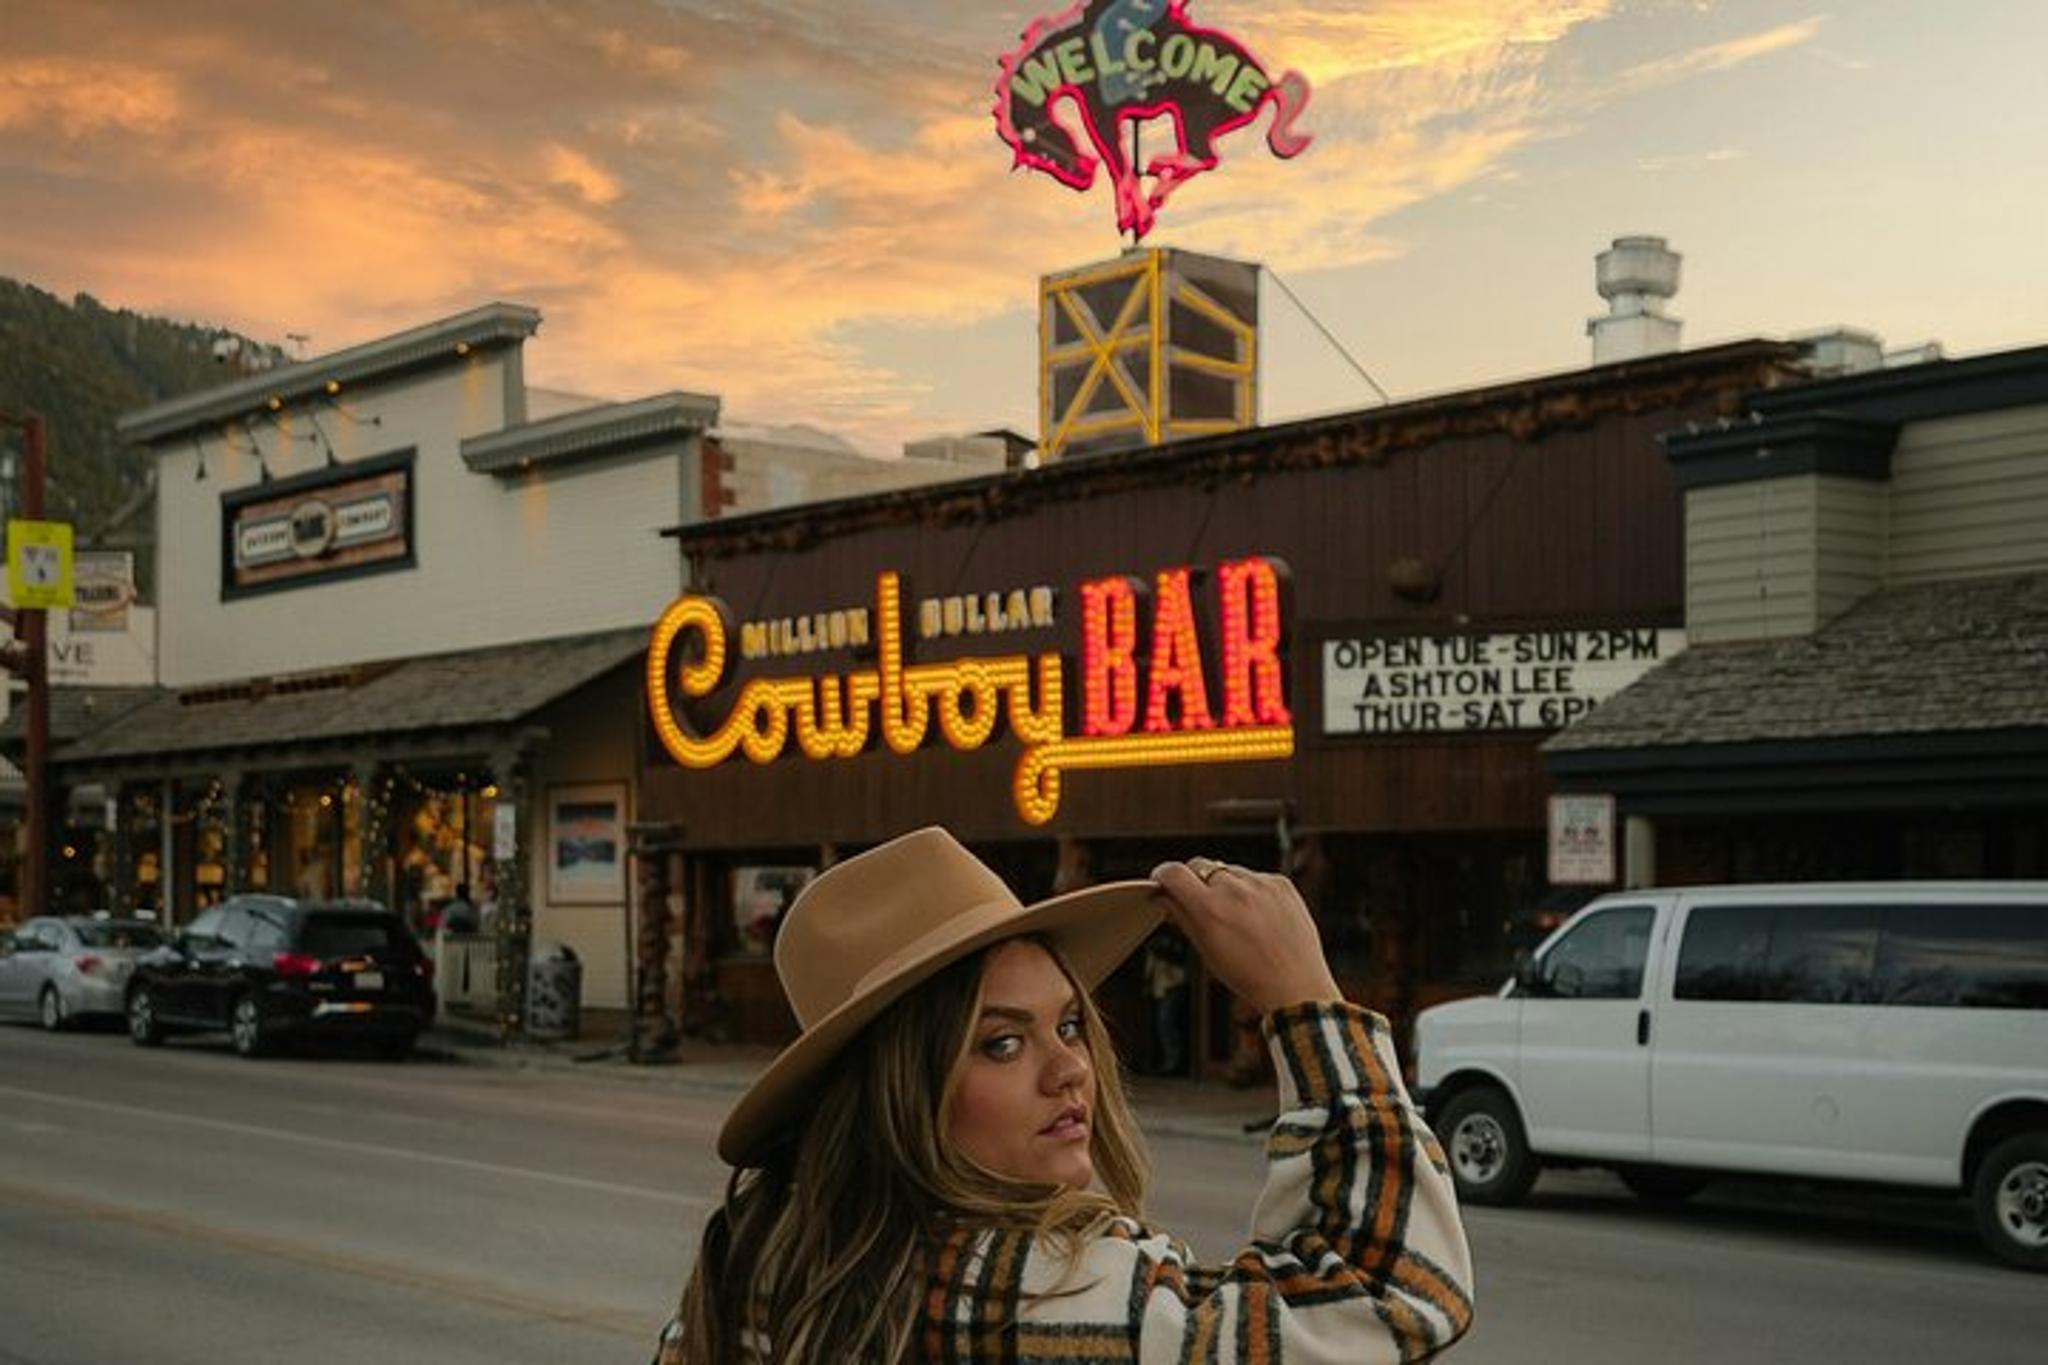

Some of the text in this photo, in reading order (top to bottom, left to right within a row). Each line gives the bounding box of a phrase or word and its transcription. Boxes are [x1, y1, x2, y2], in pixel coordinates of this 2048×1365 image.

[1011, 29, 1269, 112] WELCOME
[741, 586, 1053, 659] MILLION DOLLAR
[1334, 637, 1423, 668] OPEN
[1586, 629, 1658, 660] 2PM
[648, 556, 1292, 826] Cowboy BAR
[1362, 667, 1574, 699] ASHTON LEE
[1539, 698, 1597, 726] 6P
